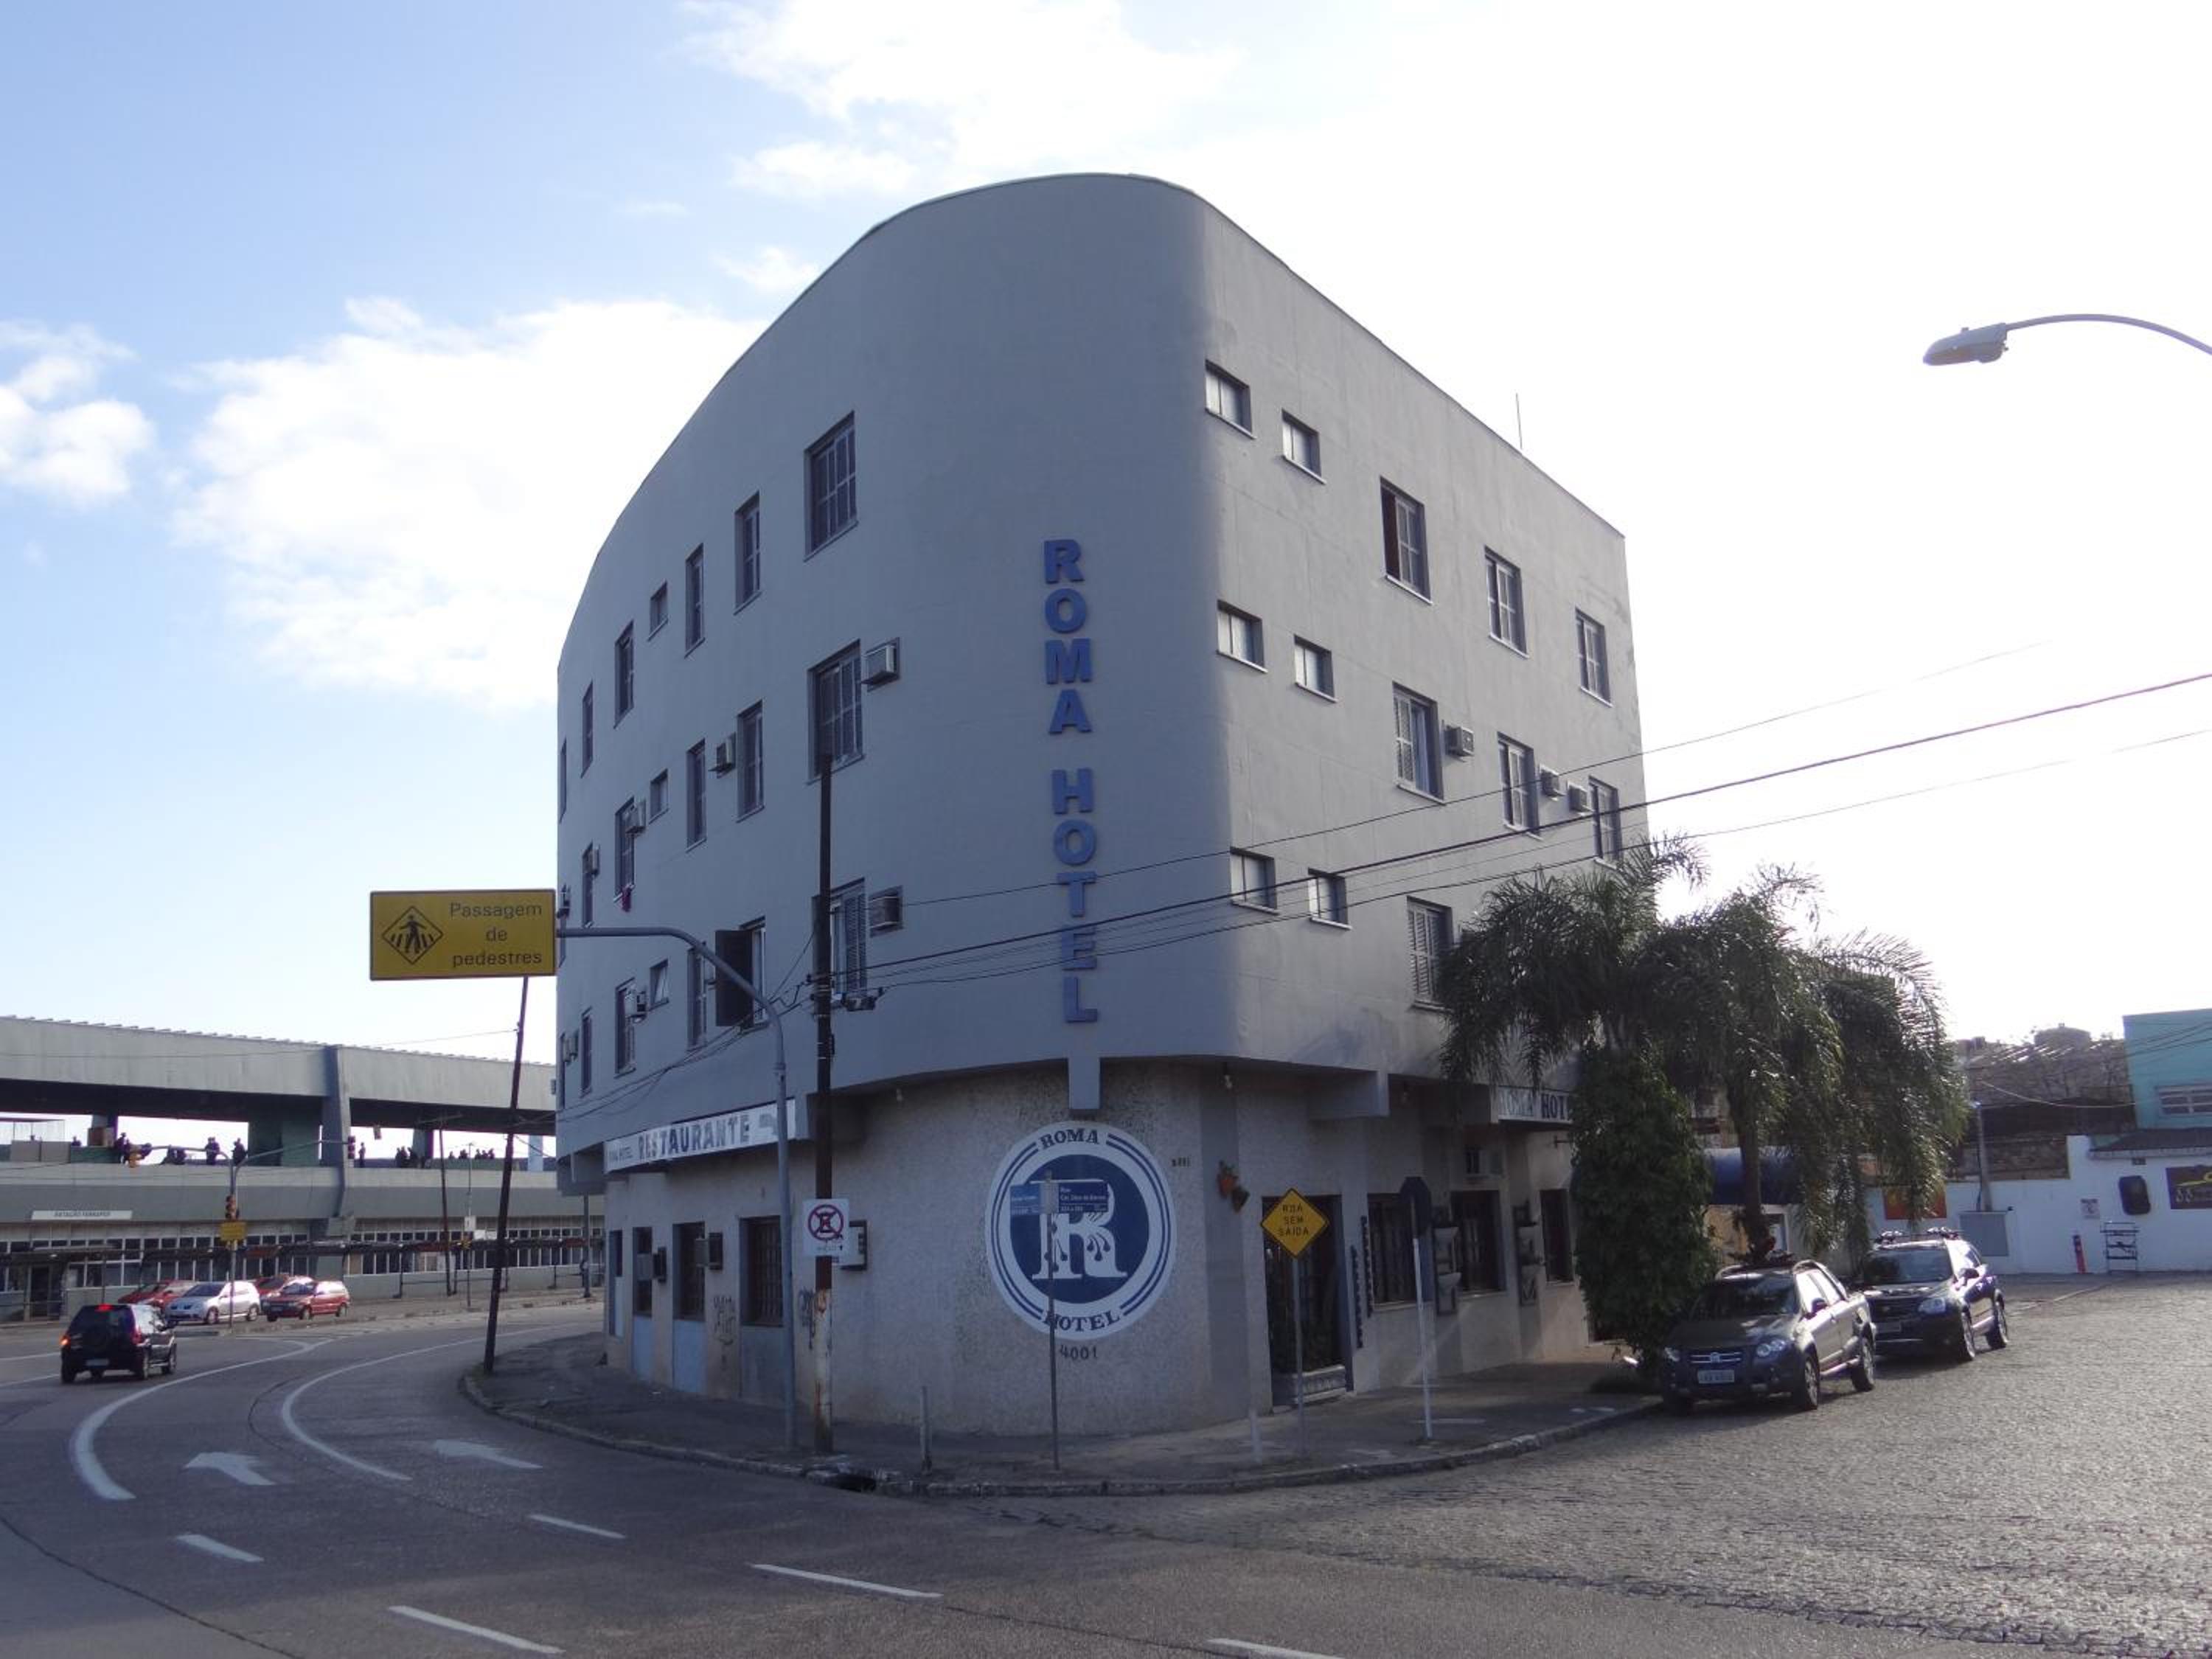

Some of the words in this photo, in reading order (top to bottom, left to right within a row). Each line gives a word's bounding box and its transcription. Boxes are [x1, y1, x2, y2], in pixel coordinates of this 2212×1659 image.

[1043, 538, 1093, 734] ROMA
[1051, 767, 1098, 1023] HOTEL
[450, 902, 543, 919] Passagem
[485, 926, 508, 942] de
[452, 950, 543, 968] pedestres
[638, 1114, 750, 1160] RESTAURANTE
[1038, 1128, 1099, 1150] ROMA
[1284, 1216, 1304, 1224] SEM
[1043, 1311, 1121, 1332] HOTEL
[1059, 1344, 1098, 1361] 4001
